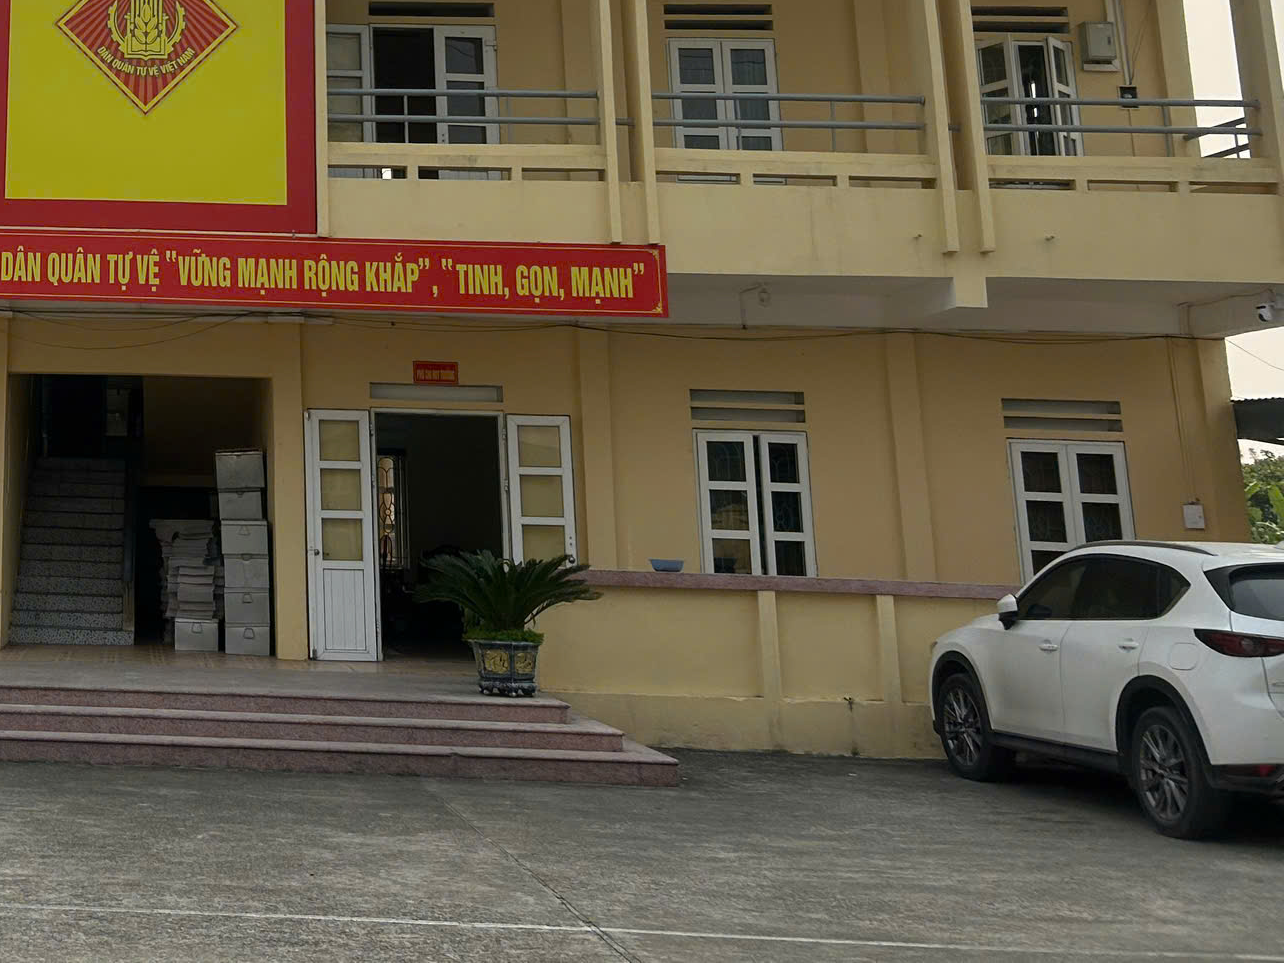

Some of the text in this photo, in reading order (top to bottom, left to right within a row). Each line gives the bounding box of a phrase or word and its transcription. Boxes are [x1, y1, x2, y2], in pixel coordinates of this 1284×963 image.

[160, 59, 179, 74] VIỆT
[177, 47, 196, 66] NAM
[0, 245, 41, 282] DÂN
[47, 246, 101, 285] QUÂN
[107, 251, 133, 291] TỰ
[136, 248, 160, 292] VỆ
[237, 257, 298, 295] MẠNH
[303, 253, 359, 297] RỘNG
[515, 264, 565, 303] GỌN,
